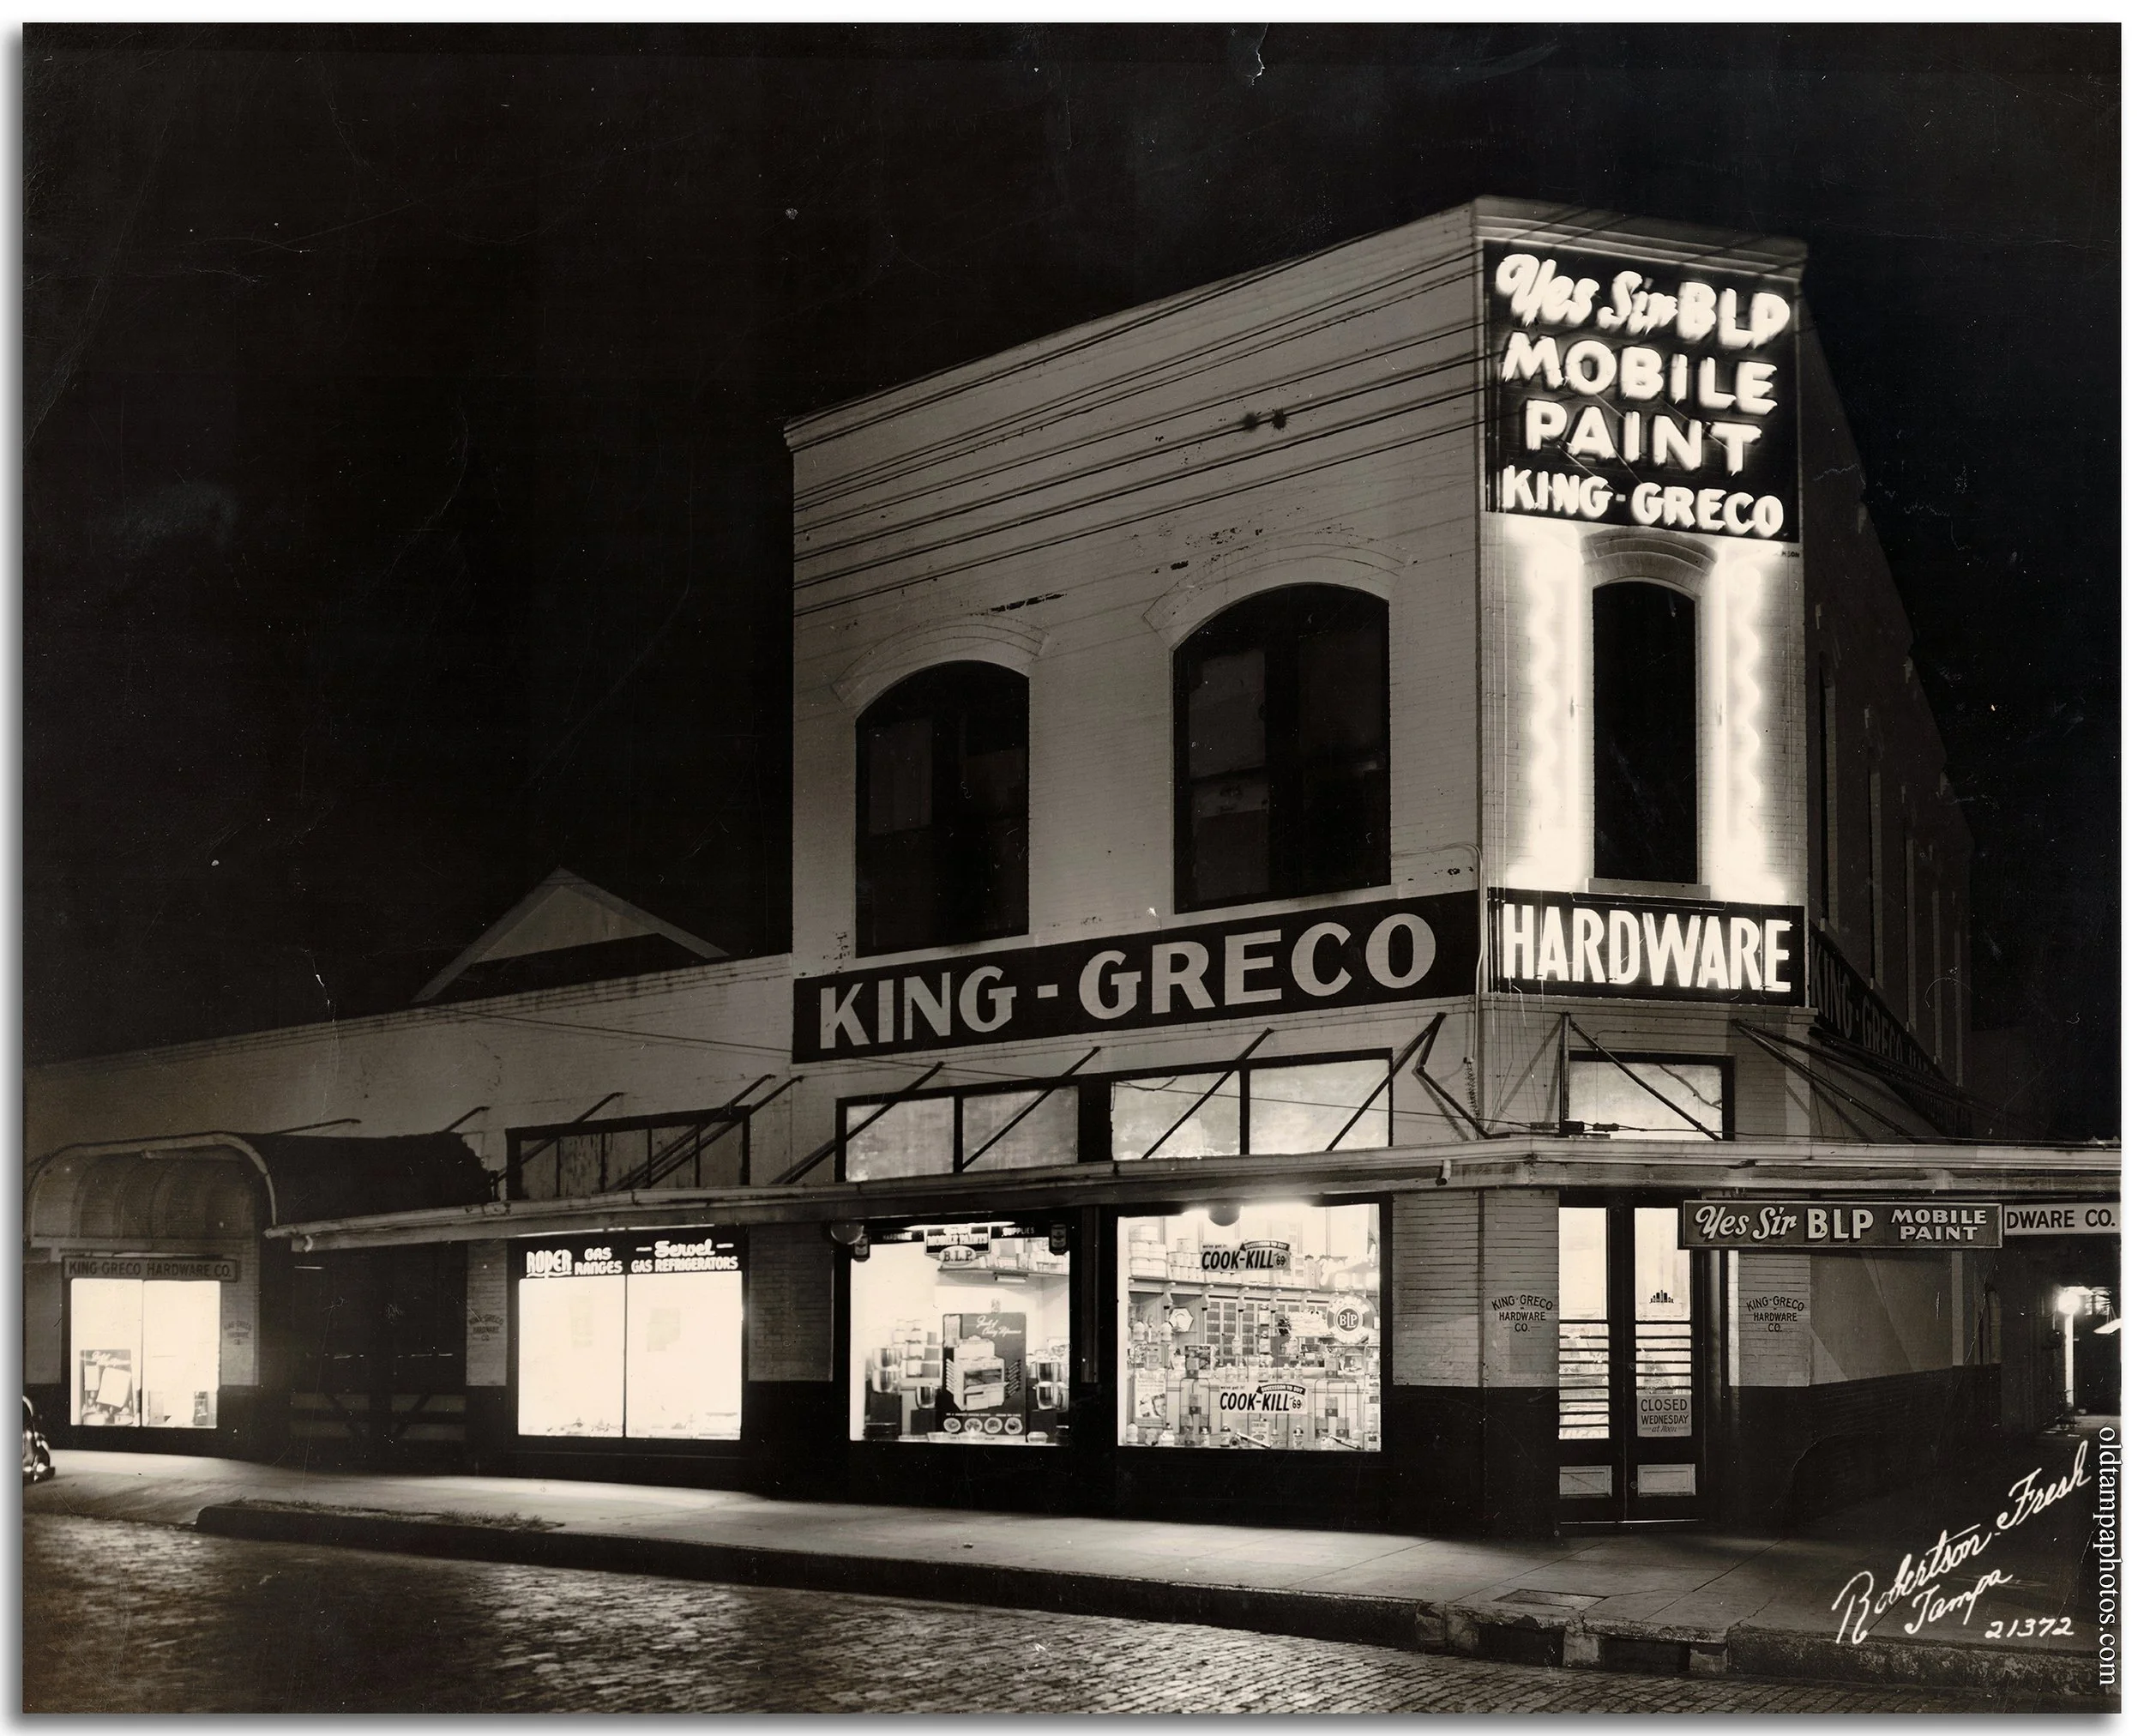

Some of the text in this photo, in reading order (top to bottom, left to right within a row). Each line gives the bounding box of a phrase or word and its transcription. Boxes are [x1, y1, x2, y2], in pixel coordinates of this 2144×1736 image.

[1496, 253, 1600, 327] Yes
[1676, 281, 1791, 349] BLP
[1502, 330, 1778, 416] MOBILE
[1525, 399, 1762, 476] PAINT
[1503, 903, 1792, 992] HARDWARE
[1695, 1206, 1874, 1240] Yes Sir BLP
[1891, 1209, 1987, 1225] MOBILE
[2085, 1209, 2117, 1227] CO.
[1900, 1226, 1978, 1241] PAINT
[584, 1247, 612, 1261] GAS
[654, 1239, 716, 1258] Servel
[574, 1260, 623, 1275] RANGES
[630, 1256, 738, 1273] GAS REFRIGERATORS
[1201, 1251, 1286, 1269] COOK-KILL 69
[147, 1263, 211, 1277] HARDWARE
[214, 1264, 232, 1278] CO.
[1339, 1312, 1358, 1329] BLP
[1498, 1311, 1546, 1321] HARDWARE
[1754, 1312, 1798, 1322] HARDWARE
[1515, 1323, 1530, 1332] CO.
[1768, 1323, 1783, 1332] CO.
[1220, 1392, 1302, 1411] COOK-KILL 69
[1641, 1398, 1688, 1412] CLOSED
[1641, 1414, 1689, 1425] WEDNESDAY
